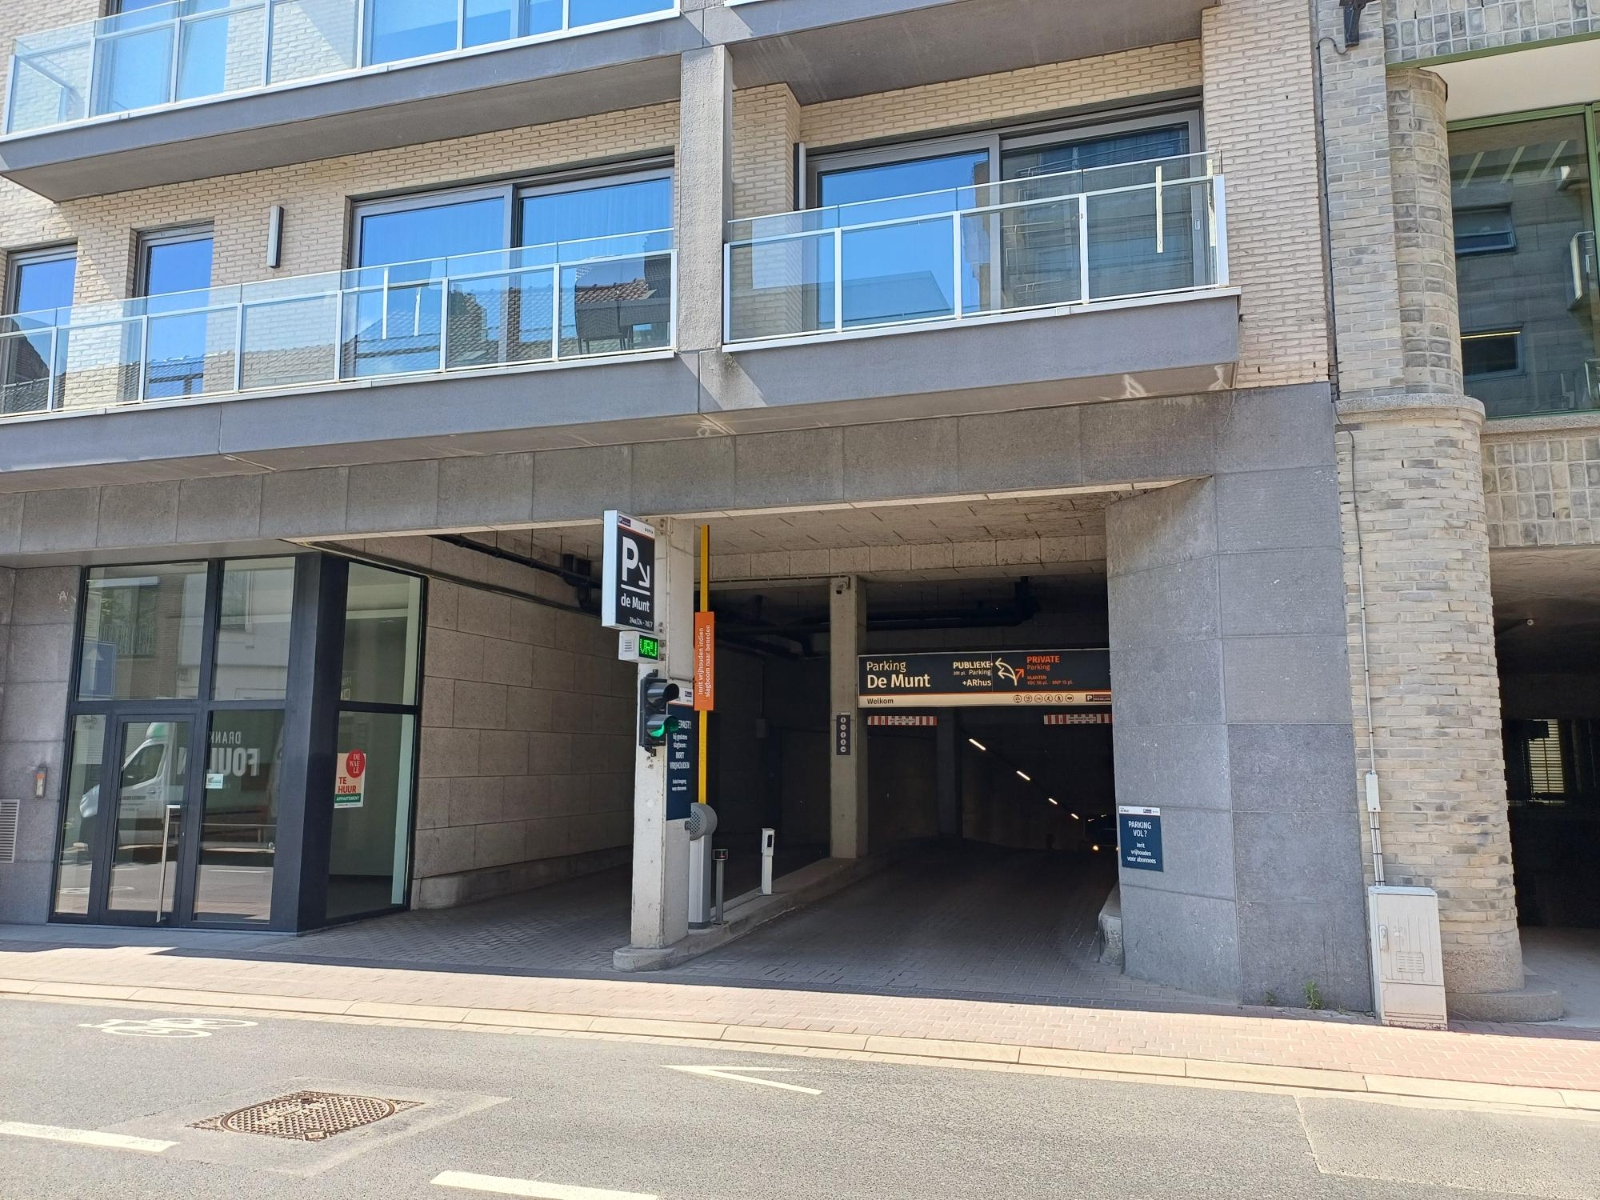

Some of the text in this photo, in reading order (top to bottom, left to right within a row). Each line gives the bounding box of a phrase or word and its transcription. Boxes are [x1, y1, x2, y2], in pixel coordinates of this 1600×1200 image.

[622, 535, 639, 582] P
[620, 593, 650, 612] de Munt
[866, 660, 906, 672] Parking
[953, 661, 991, 669] PUBLIEKE
[867, 674, 931, 688] De Munt
[1128, 821, 1152, 829] PARKING
[1137, 856, 1156, 864] abonnees
